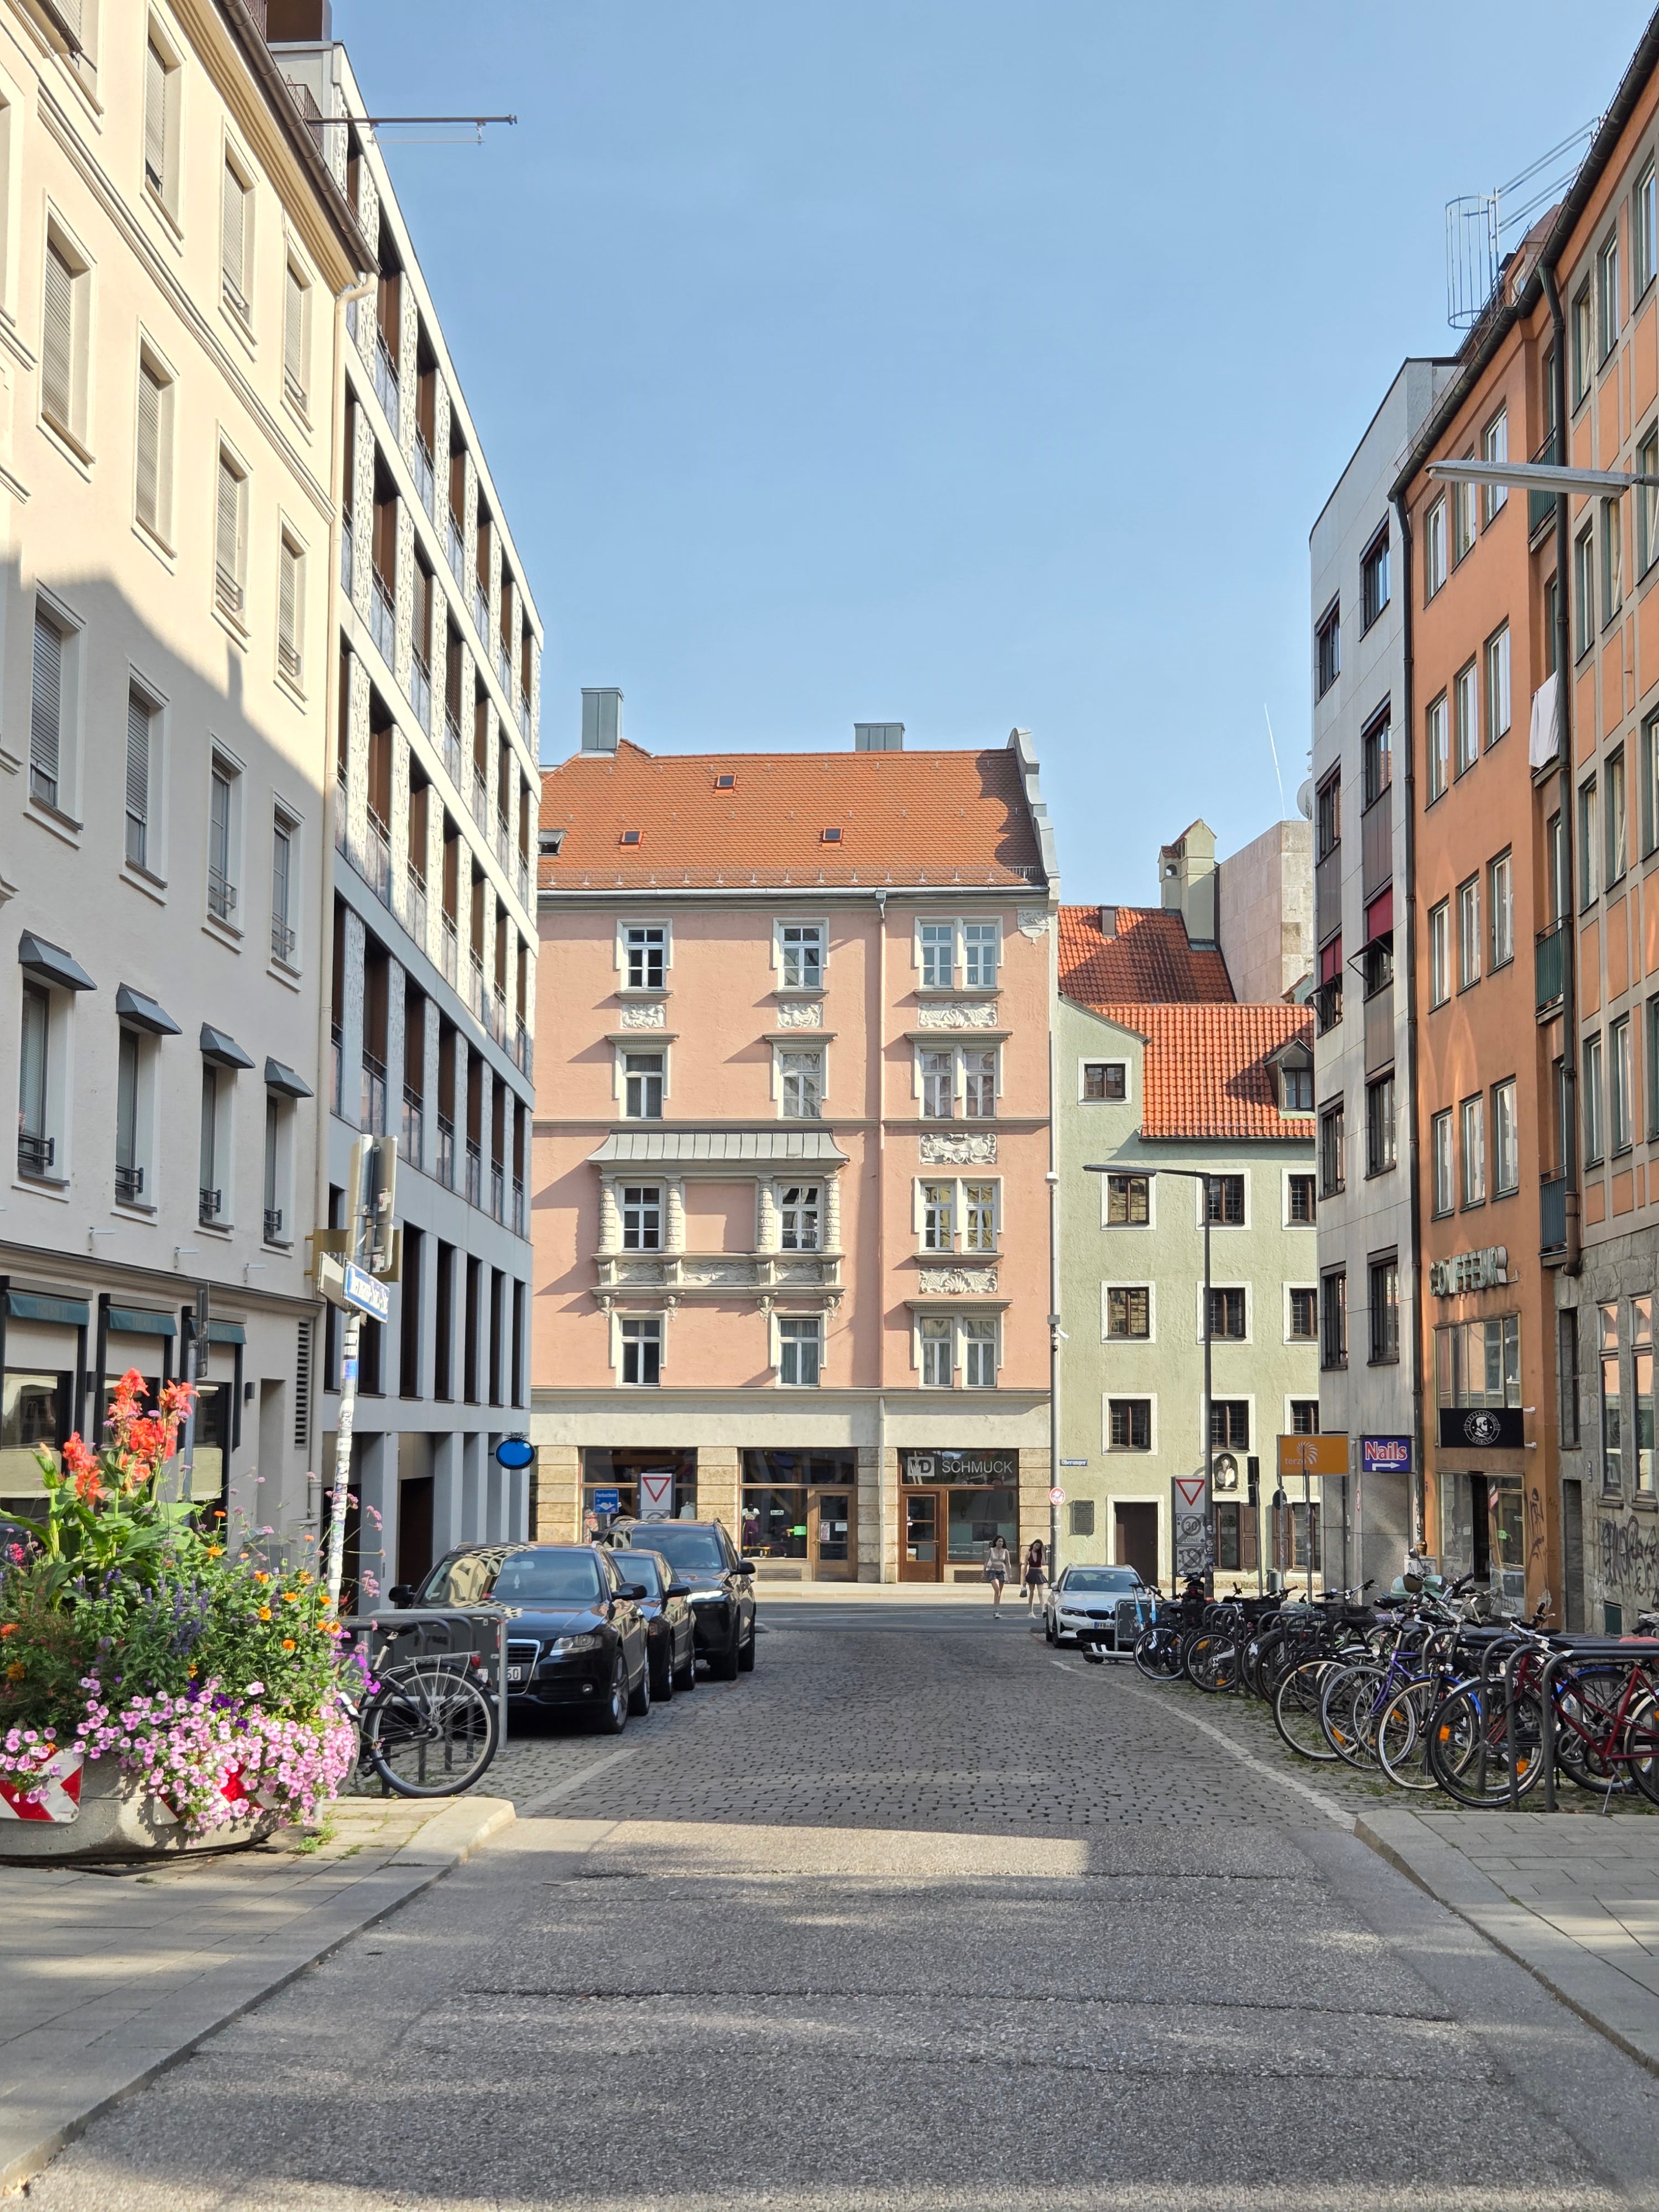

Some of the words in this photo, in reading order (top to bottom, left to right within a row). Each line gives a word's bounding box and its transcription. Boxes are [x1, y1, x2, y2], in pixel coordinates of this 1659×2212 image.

[1430, 1246, 1507, 1297] COIFFEUR
[1365, 1441, 1407, 1460] Nails
[942, 1460, 1013, 1473] SCHMUCK
[1185, 1521, 1198, 1531] 30
